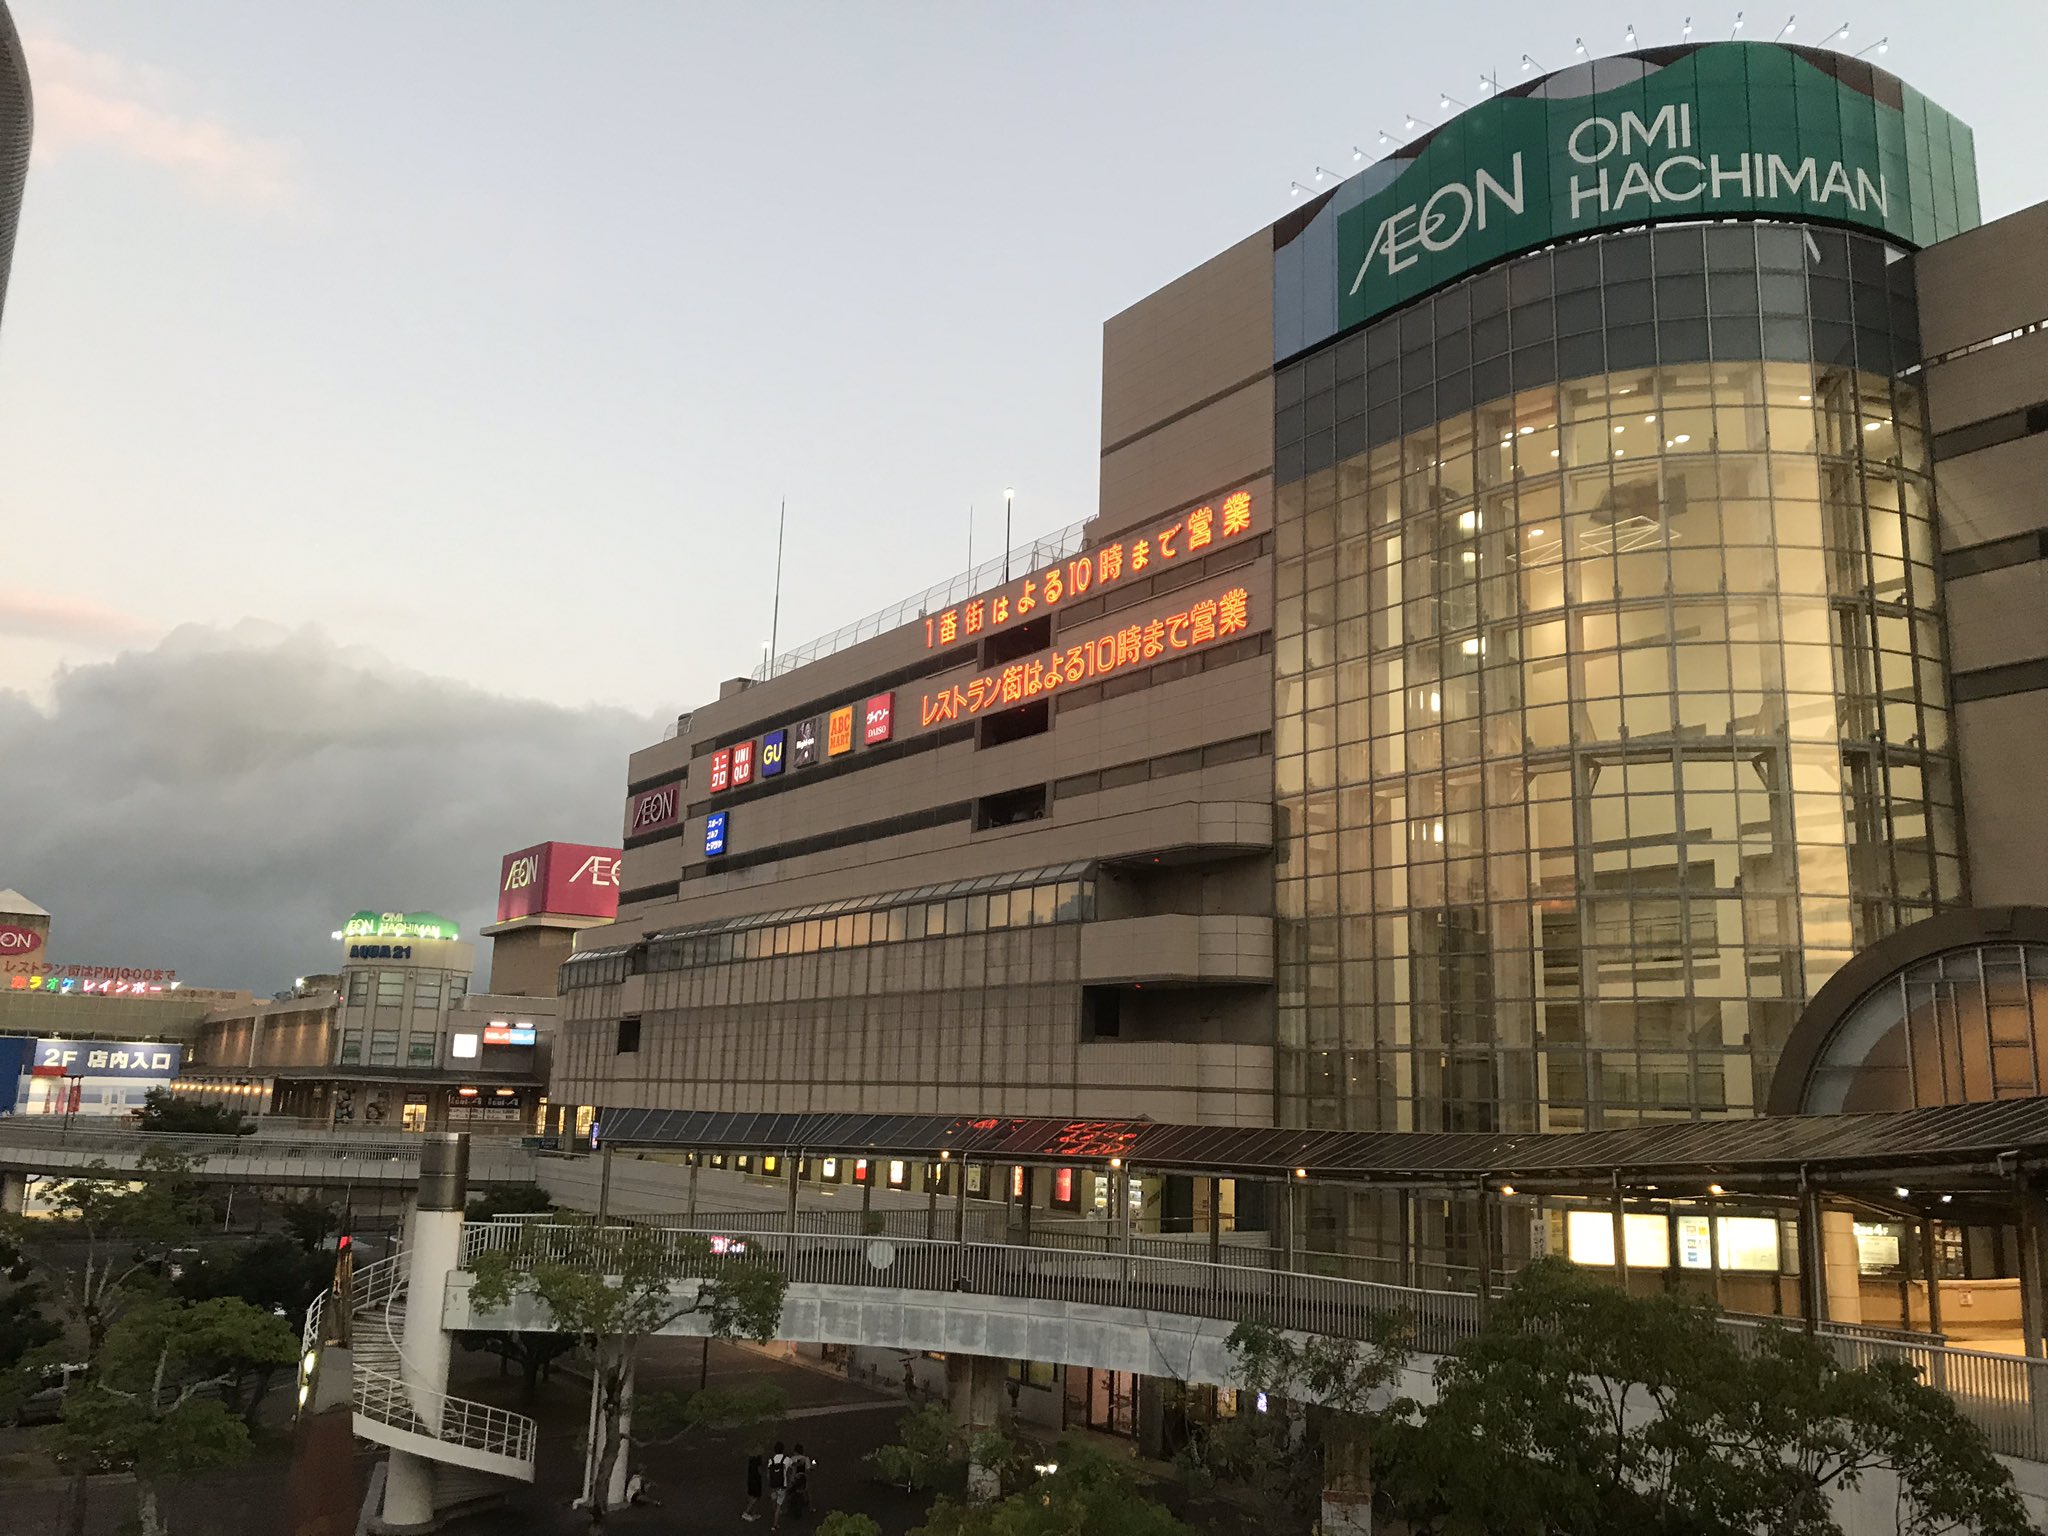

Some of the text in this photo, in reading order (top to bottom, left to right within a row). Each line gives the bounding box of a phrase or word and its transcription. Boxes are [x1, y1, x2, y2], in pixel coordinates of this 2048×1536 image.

[1567, 103, 1692, 164] OMI
[1568, 152, 1888, 219] HACHIMAN
[922, 587, 1248, 727] レストラン街はよる10時まで営業
[831, 713, 850, 735] ABC
[867, 724, 887, 738] DAISO
[830, 732, 850, 749] MART
[735, 746, 750, 764] UNI
[763, 741, 783, 765] GU
[713, 754, 727, 771] ユニ
[711, 770, 726, 787] クロ
[734, 763, 749, 782] QLO
[381, 912, 403, 922] OMI
[380, 922, 441, 936] HACHIMAN
[349, 945, 411, 959] AQUA 21
[83, 979, 162, 994] レインボー
[43, 1048, 171, 1070] 2F 店内入口
